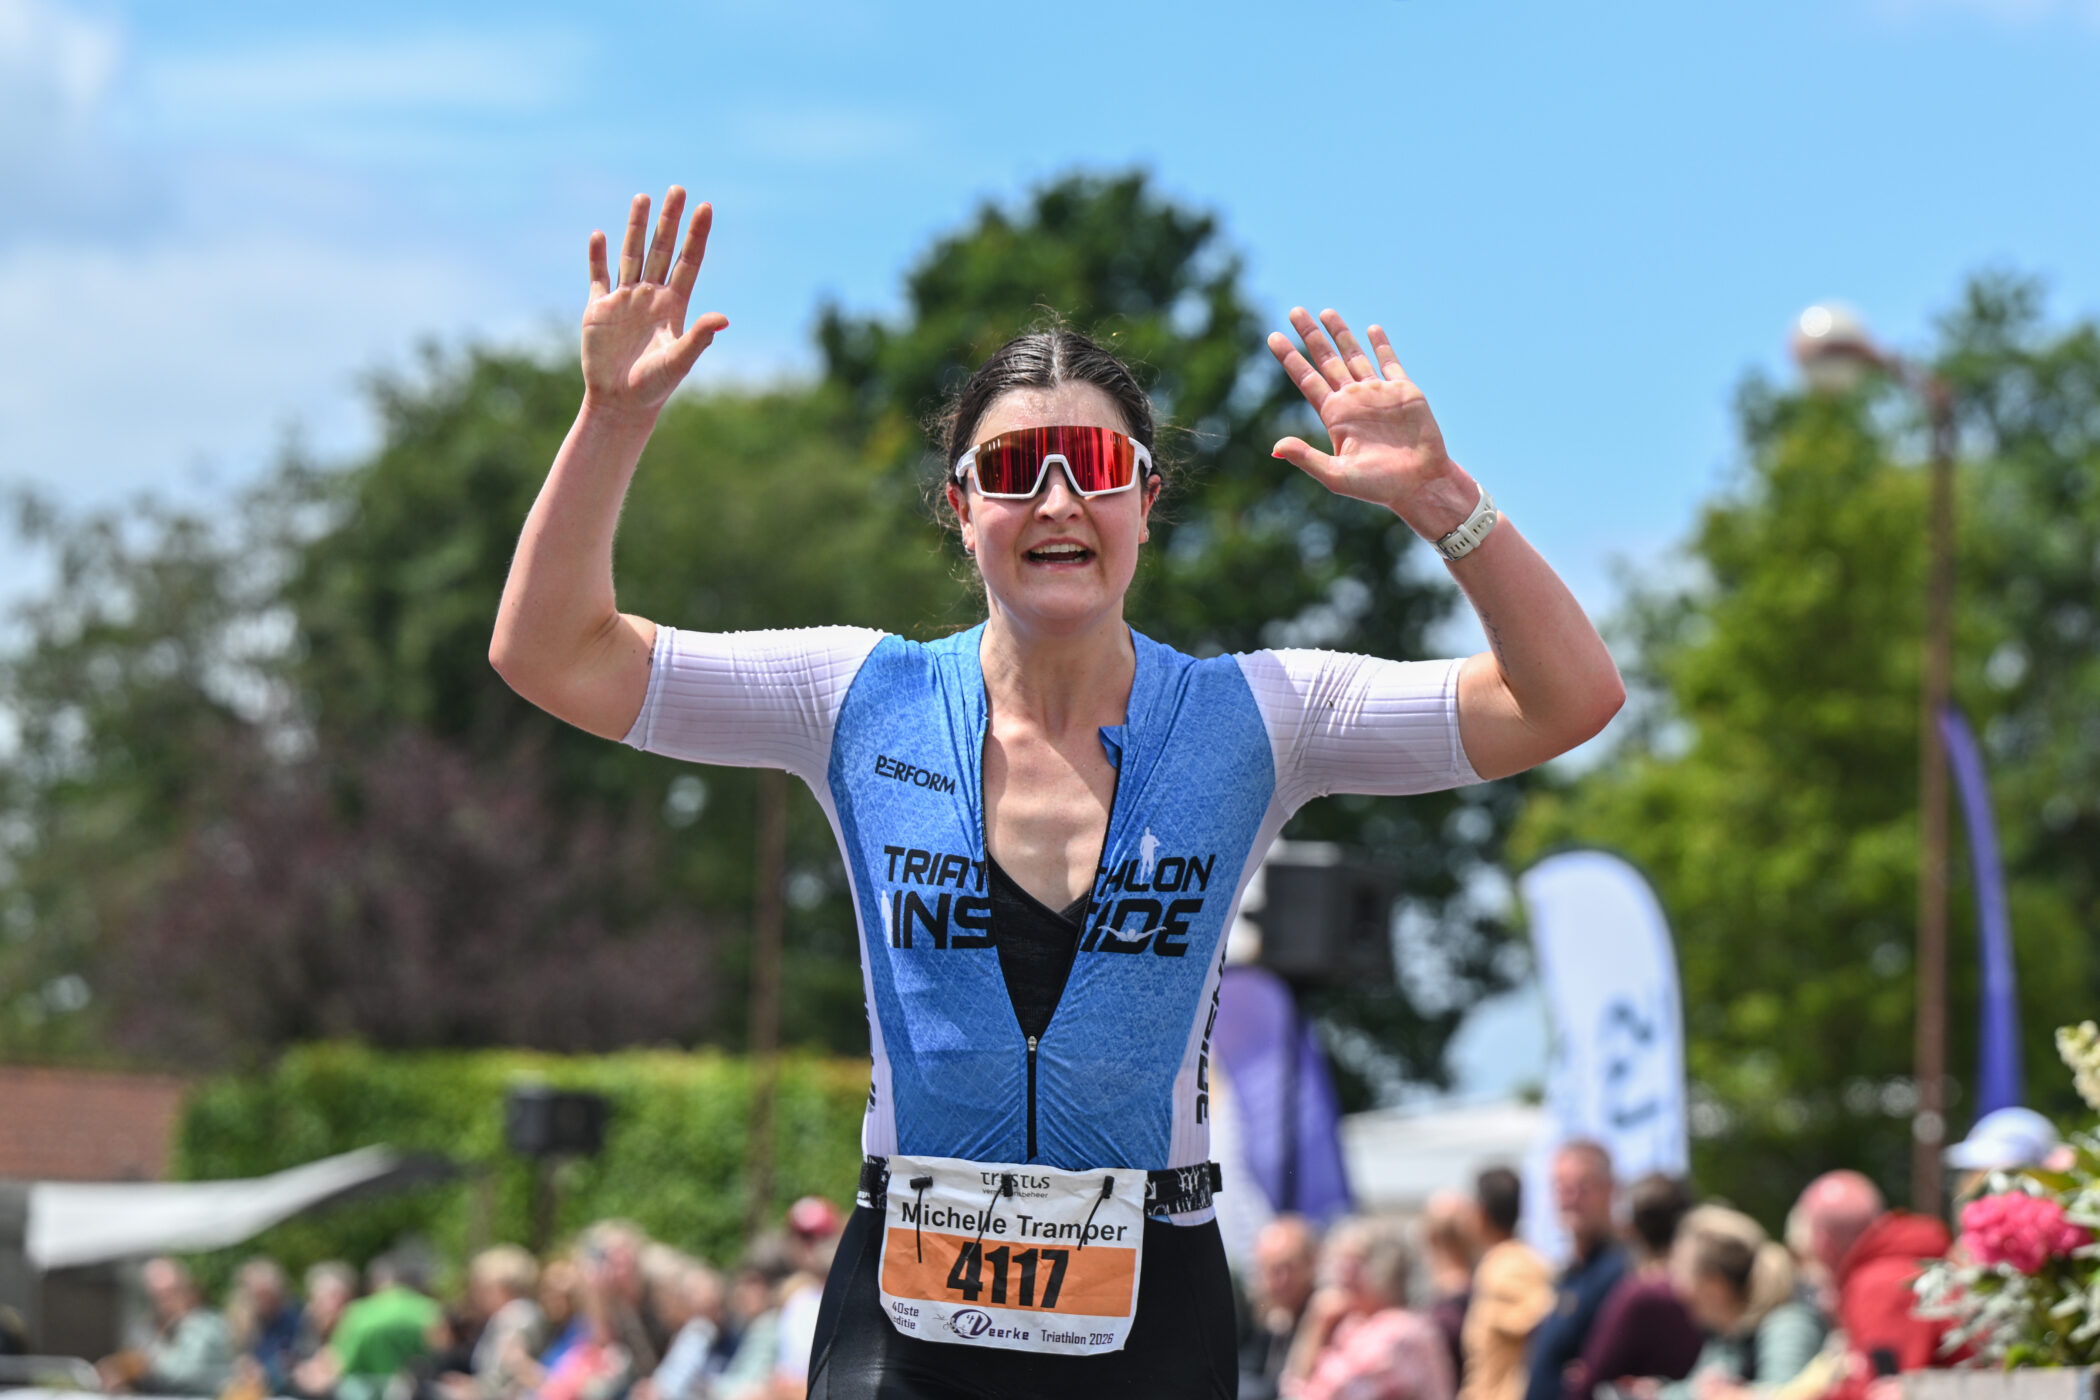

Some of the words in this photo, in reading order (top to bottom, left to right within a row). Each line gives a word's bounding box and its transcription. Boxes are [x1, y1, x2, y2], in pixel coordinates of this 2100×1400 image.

[875, 754, 957, 795] PERFORM
[980, 1171, 1051, 1190] trstus
[901, 1202, 1007, 1234] Michelle
[1017, 1214, 1128, 1245] Tramper
[946, 1241, 1070, 1309] 4117
[892, 1301, 919, 1317] 40ste
[1041, 1329, 1087, 1345] Triathlon
[1089, 1333, 1115, 1346] 2026
